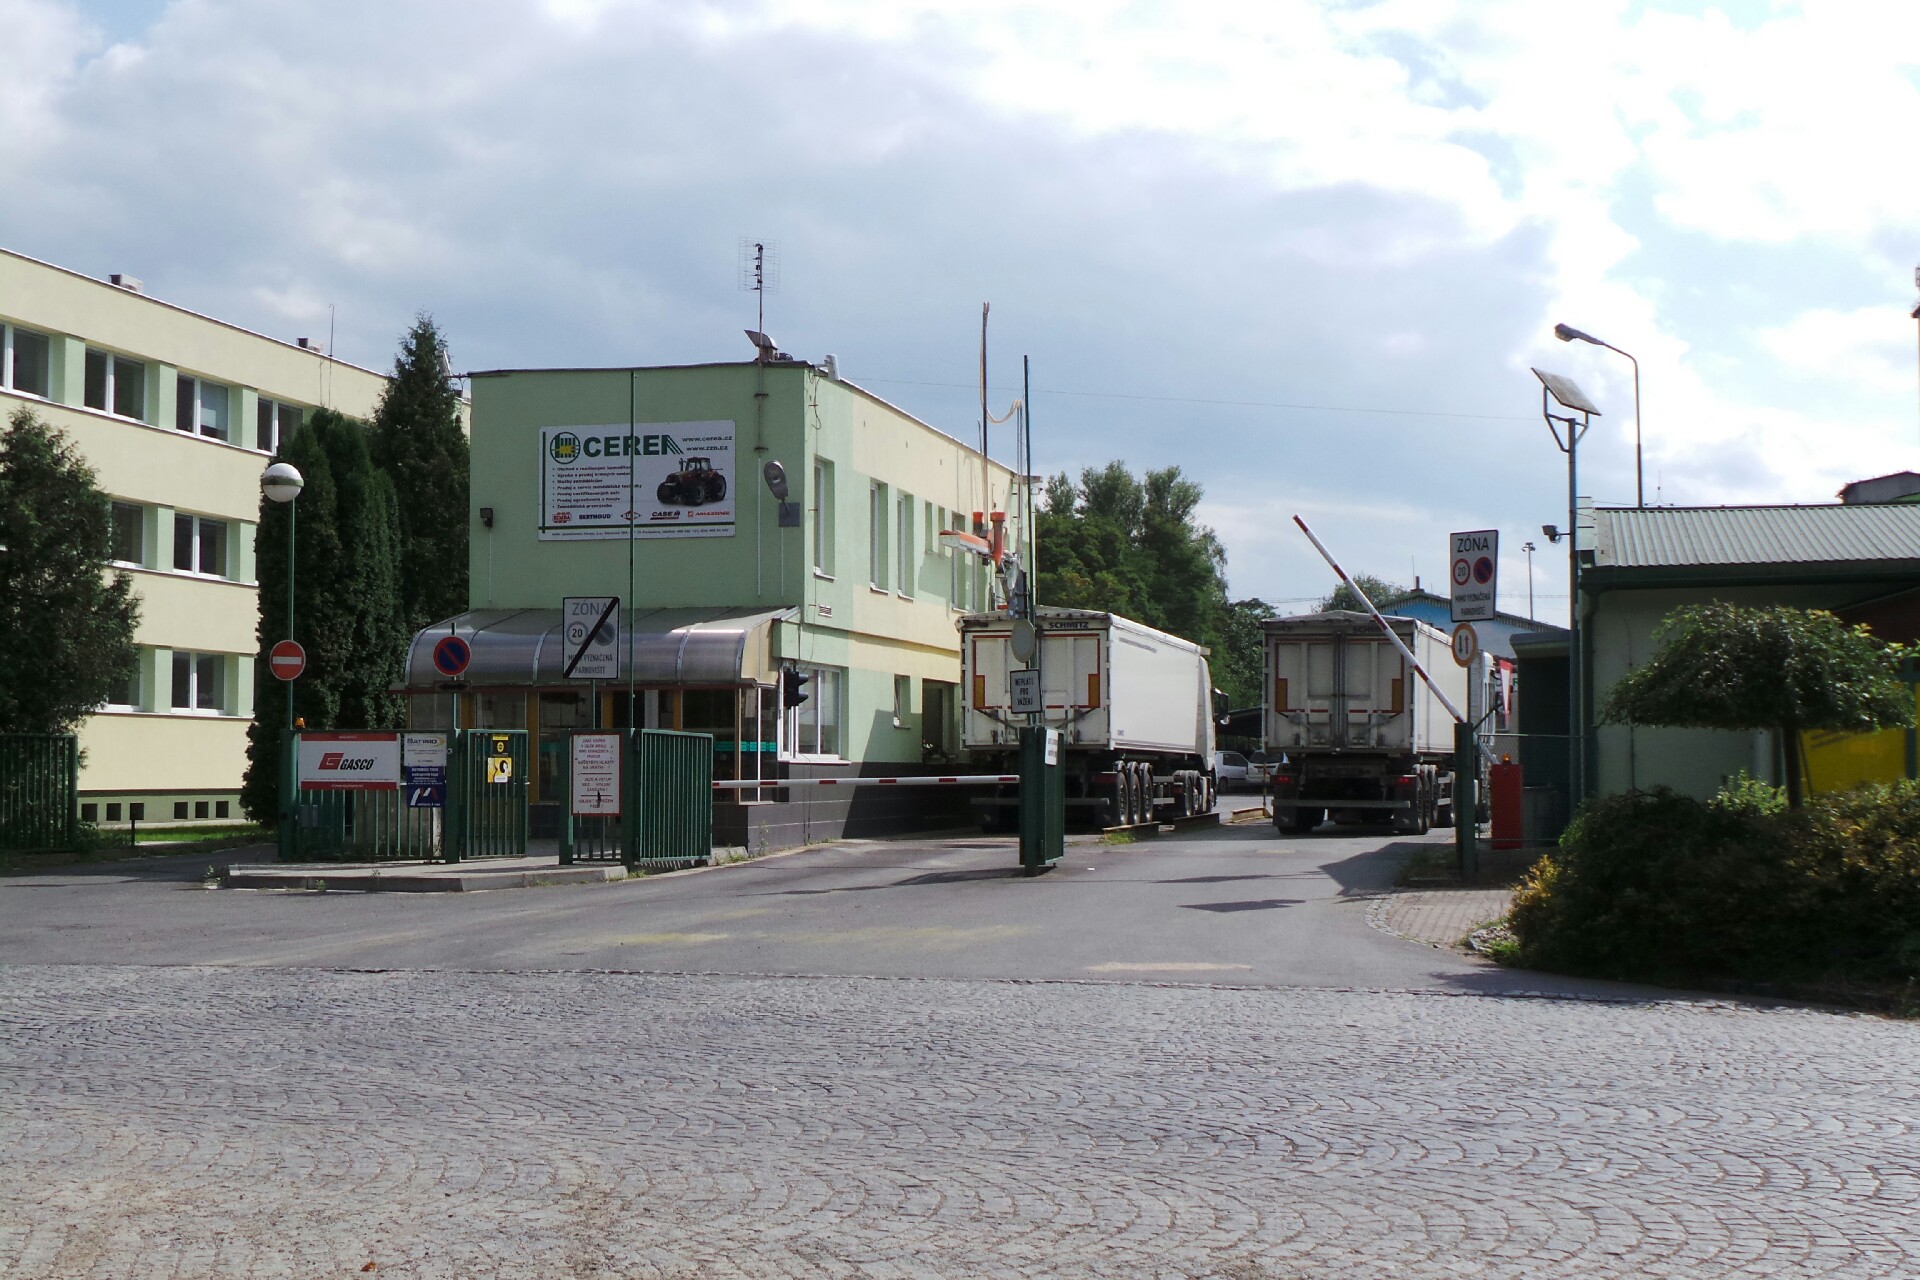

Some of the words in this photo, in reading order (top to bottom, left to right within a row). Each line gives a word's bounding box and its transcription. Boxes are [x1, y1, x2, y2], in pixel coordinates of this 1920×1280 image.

[583, 434, 684, 457] CEREA
[1458, 535, 1490, 552] ZÓNA
[1457, 566, 1466, 577] 20
[572, 600, 609, 616] ZÓNA
[572, 628, 583, 638] 20
[1019, 687, 1029, 695] PRO
[340, 758, 375, 770] GASCO
